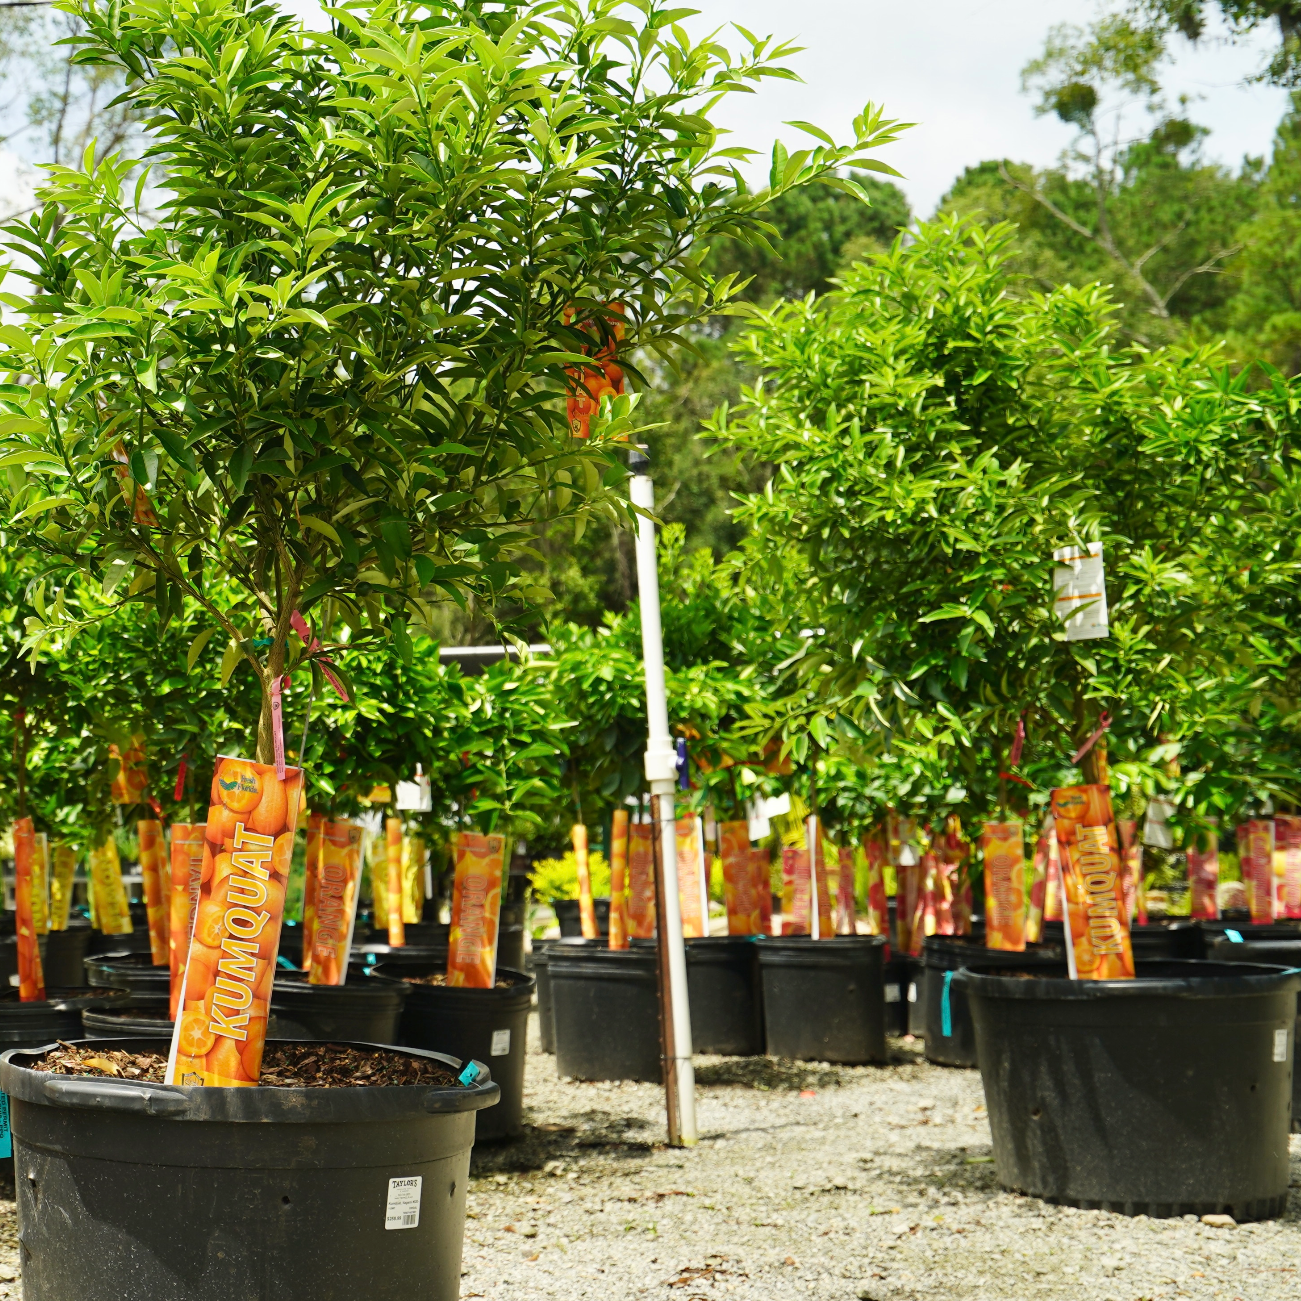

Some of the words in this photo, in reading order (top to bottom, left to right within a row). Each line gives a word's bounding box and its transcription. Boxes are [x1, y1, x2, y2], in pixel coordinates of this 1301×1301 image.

[240, 774, 256, 784] Fresh
[208, 821, 275, 1042] KUMQUAT
[315, 864, 347, 959] ORANGE
[456, 875, 488, 965] ORANGE
[1074, 824, 1123, 956] KUMQUAT
